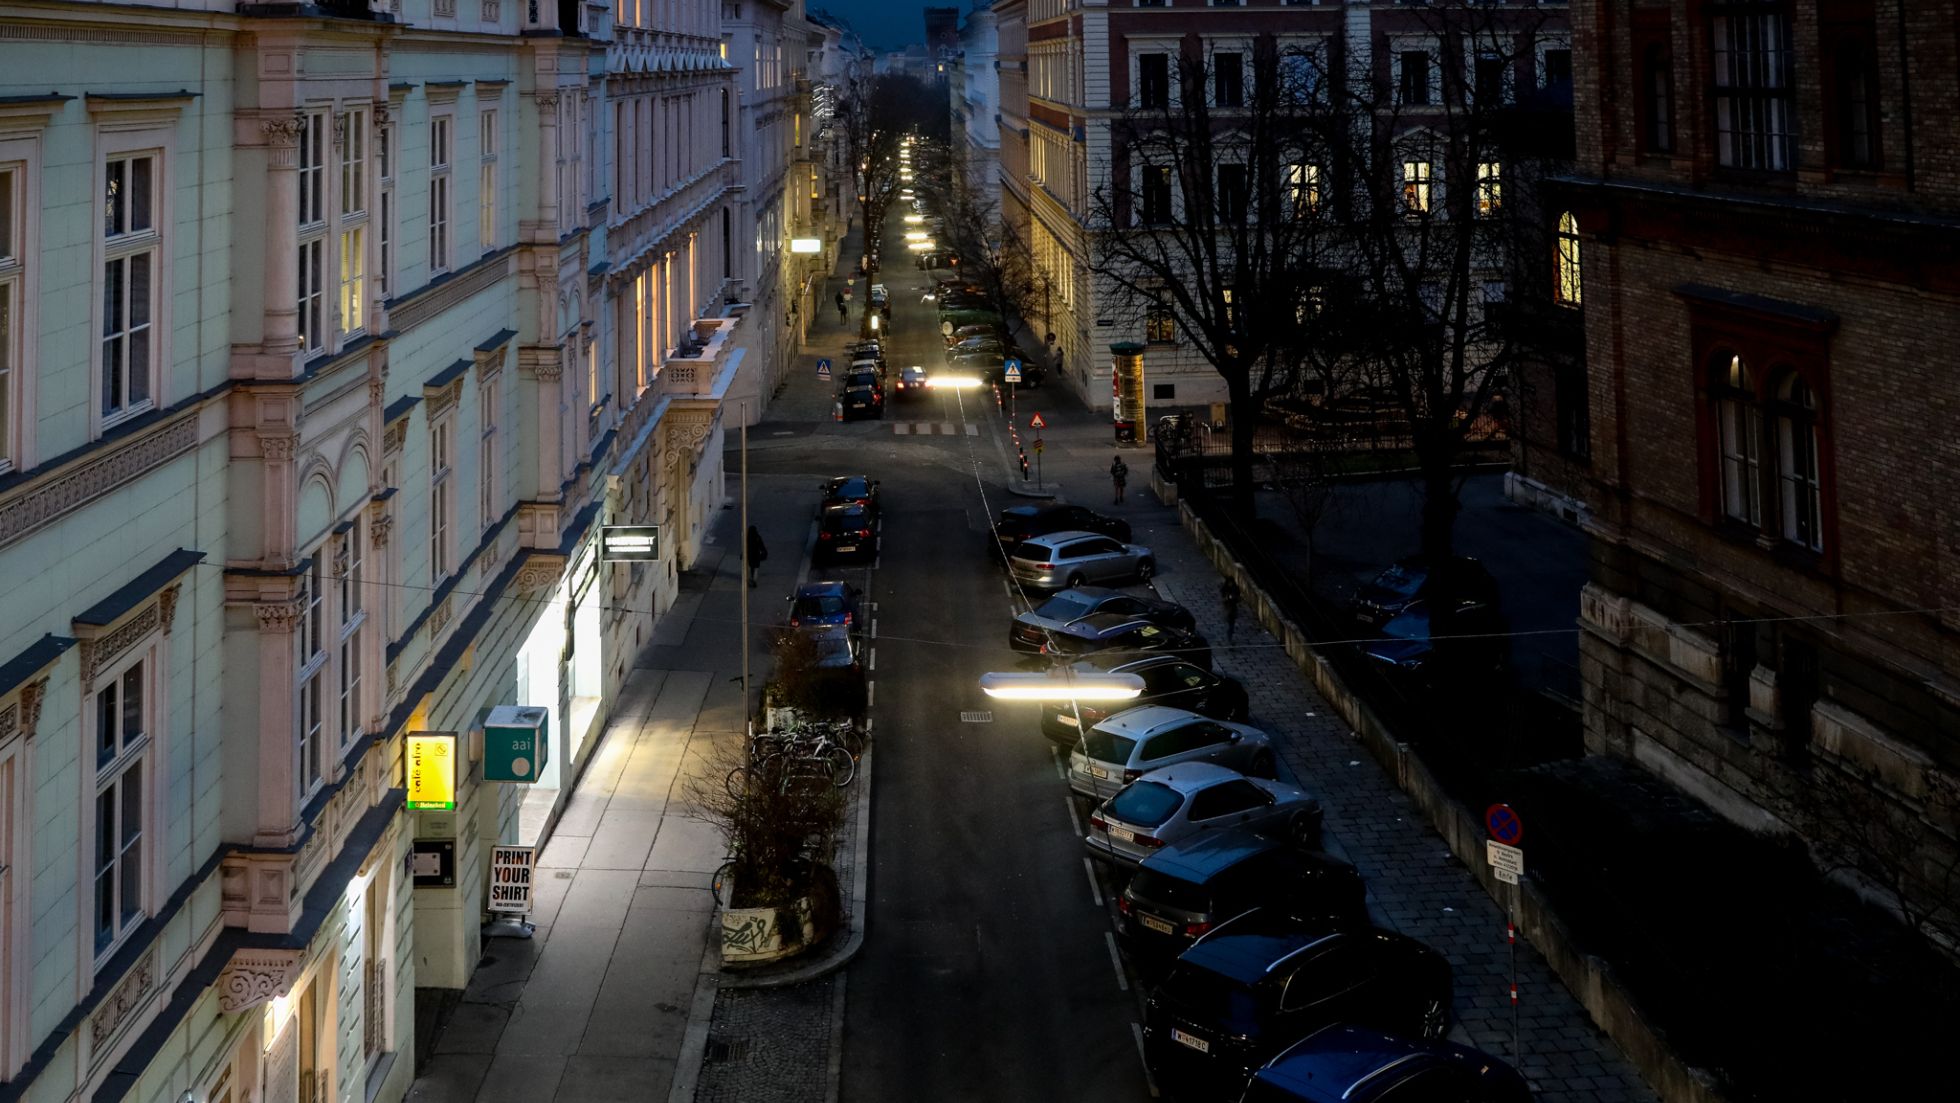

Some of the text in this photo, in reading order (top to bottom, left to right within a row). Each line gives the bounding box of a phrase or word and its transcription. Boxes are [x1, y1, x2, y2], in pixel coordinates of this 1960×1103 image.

[512, 737, 531, 750] aai
[495, 850, 532, 865] PRINT
[494, 866, 530, 884] YOUR
[492, 885, 530, 901] SHIRT
